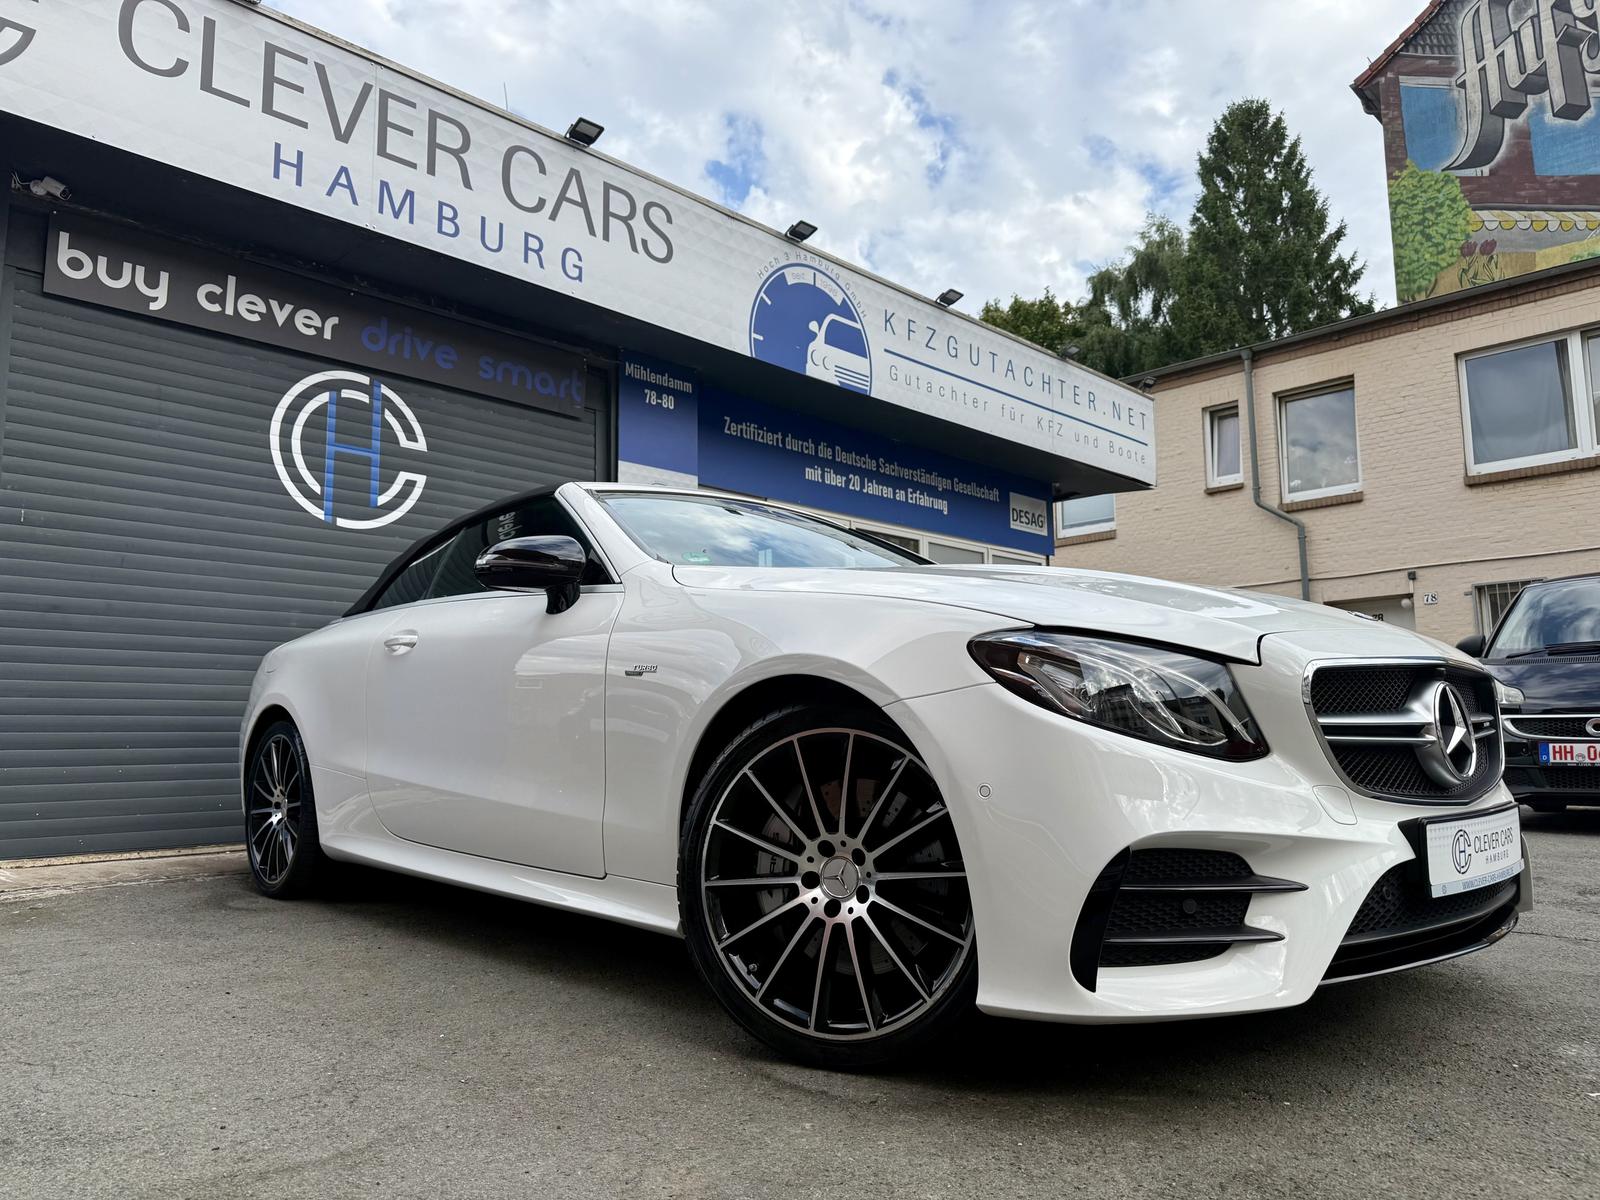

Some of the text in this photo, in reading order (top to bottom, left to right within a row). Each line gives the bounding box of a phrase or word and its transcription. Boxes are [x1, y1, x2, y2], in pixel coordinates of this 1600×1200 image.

[118, 0, 474, 191] CLEVER
[502, 144, 674, 265] CARS
[272, 141, 585, 284] HAMBURG
[56, 231, 583, 403] buy clever drive smart
[625, 361, 693, 393] Mühlendamm
[884, 308, 1147, 431] KFZGUTACHTER.NET
[644, 388, 675, 410] 78-80
[889, 365, 1146, 465] Gutachter für KFZ und Boote
[723, 416, 1000, 502] Zertifiziert durch die Deutsche Sachverständigen Gesellschaft
[805, 465, 948, 515] mit über 20 Jahren an Erfahrung
[1011, 507, 1044, 529] DESAG
[1424, 593, 1438, 603] 78
[1552, 745, 1574, 761] HH
[1473, 826, 1514, 854] CLEVER CARS
